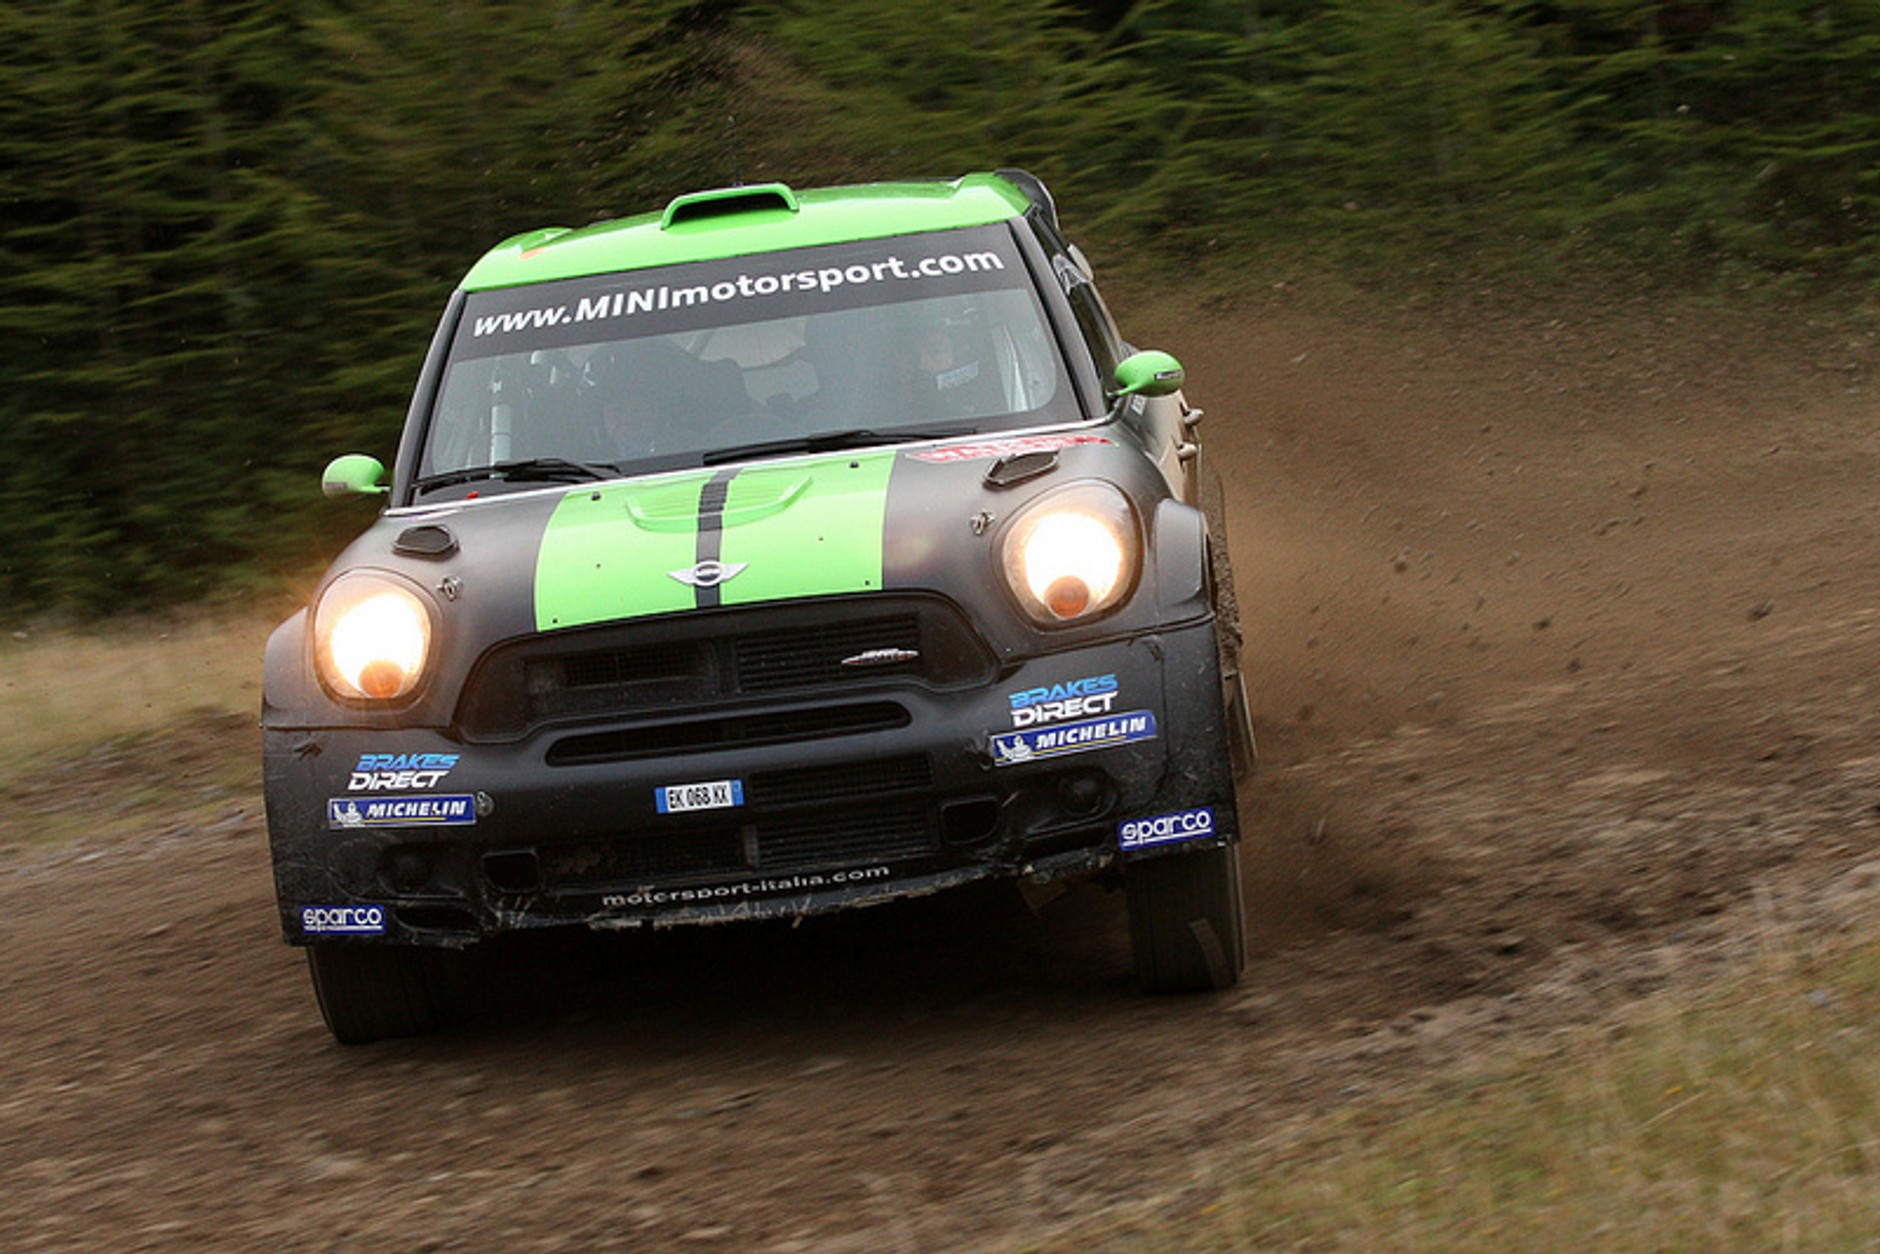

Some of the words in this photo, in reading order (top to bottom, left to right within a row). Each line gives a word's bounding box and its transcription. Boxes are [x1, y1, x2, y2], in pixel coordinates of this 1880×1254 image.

[473, 248, 1004, 337] www.MINImotorsport.com
[1008, 674, 1119, 708] BRAKES
[1011, 691, 1118, 727] DIRECT
[1036, 716, 1147, 750] MICHELIN
[355, 754, 462, 771] BRAKES
[348, 771, 450, 790] DIRECT
[367, 801, 467, 818] MICHELIN
[668, 789, 685, 808] EK
[1121, 811, 1211, 844] sparco
[303, 908, 383, 931] sparco
